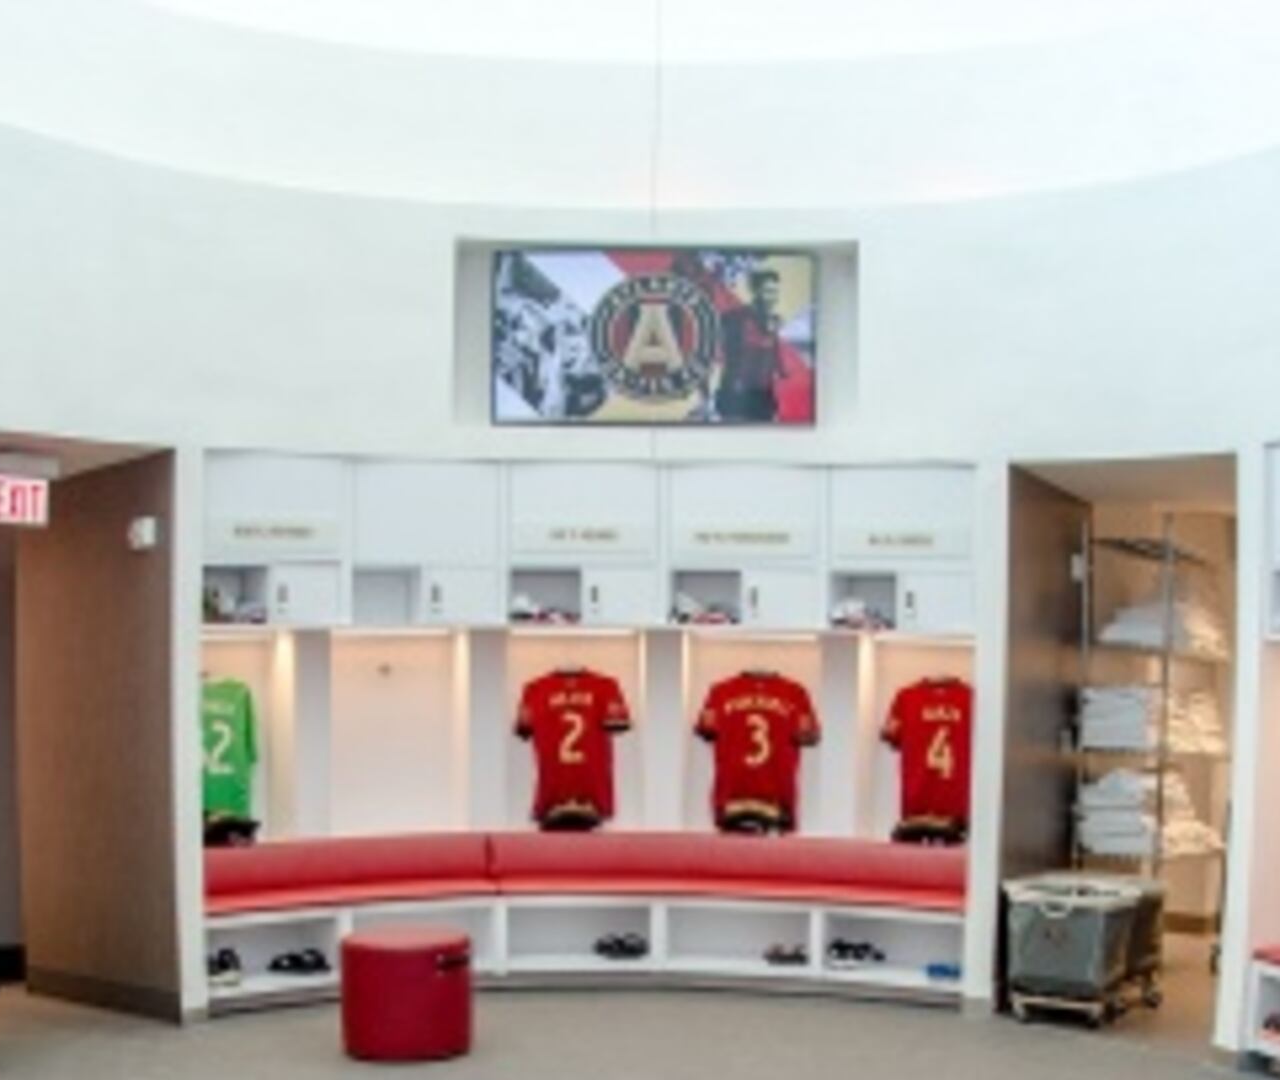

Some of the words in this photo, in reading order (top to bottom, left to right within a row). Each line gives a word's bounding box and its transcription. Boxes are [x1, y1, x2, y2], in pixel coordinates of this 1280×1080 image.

[558, 713, 586, 763] 2
[745, 715, 772, 766] 3
[926, 730, 955, 779] 4
